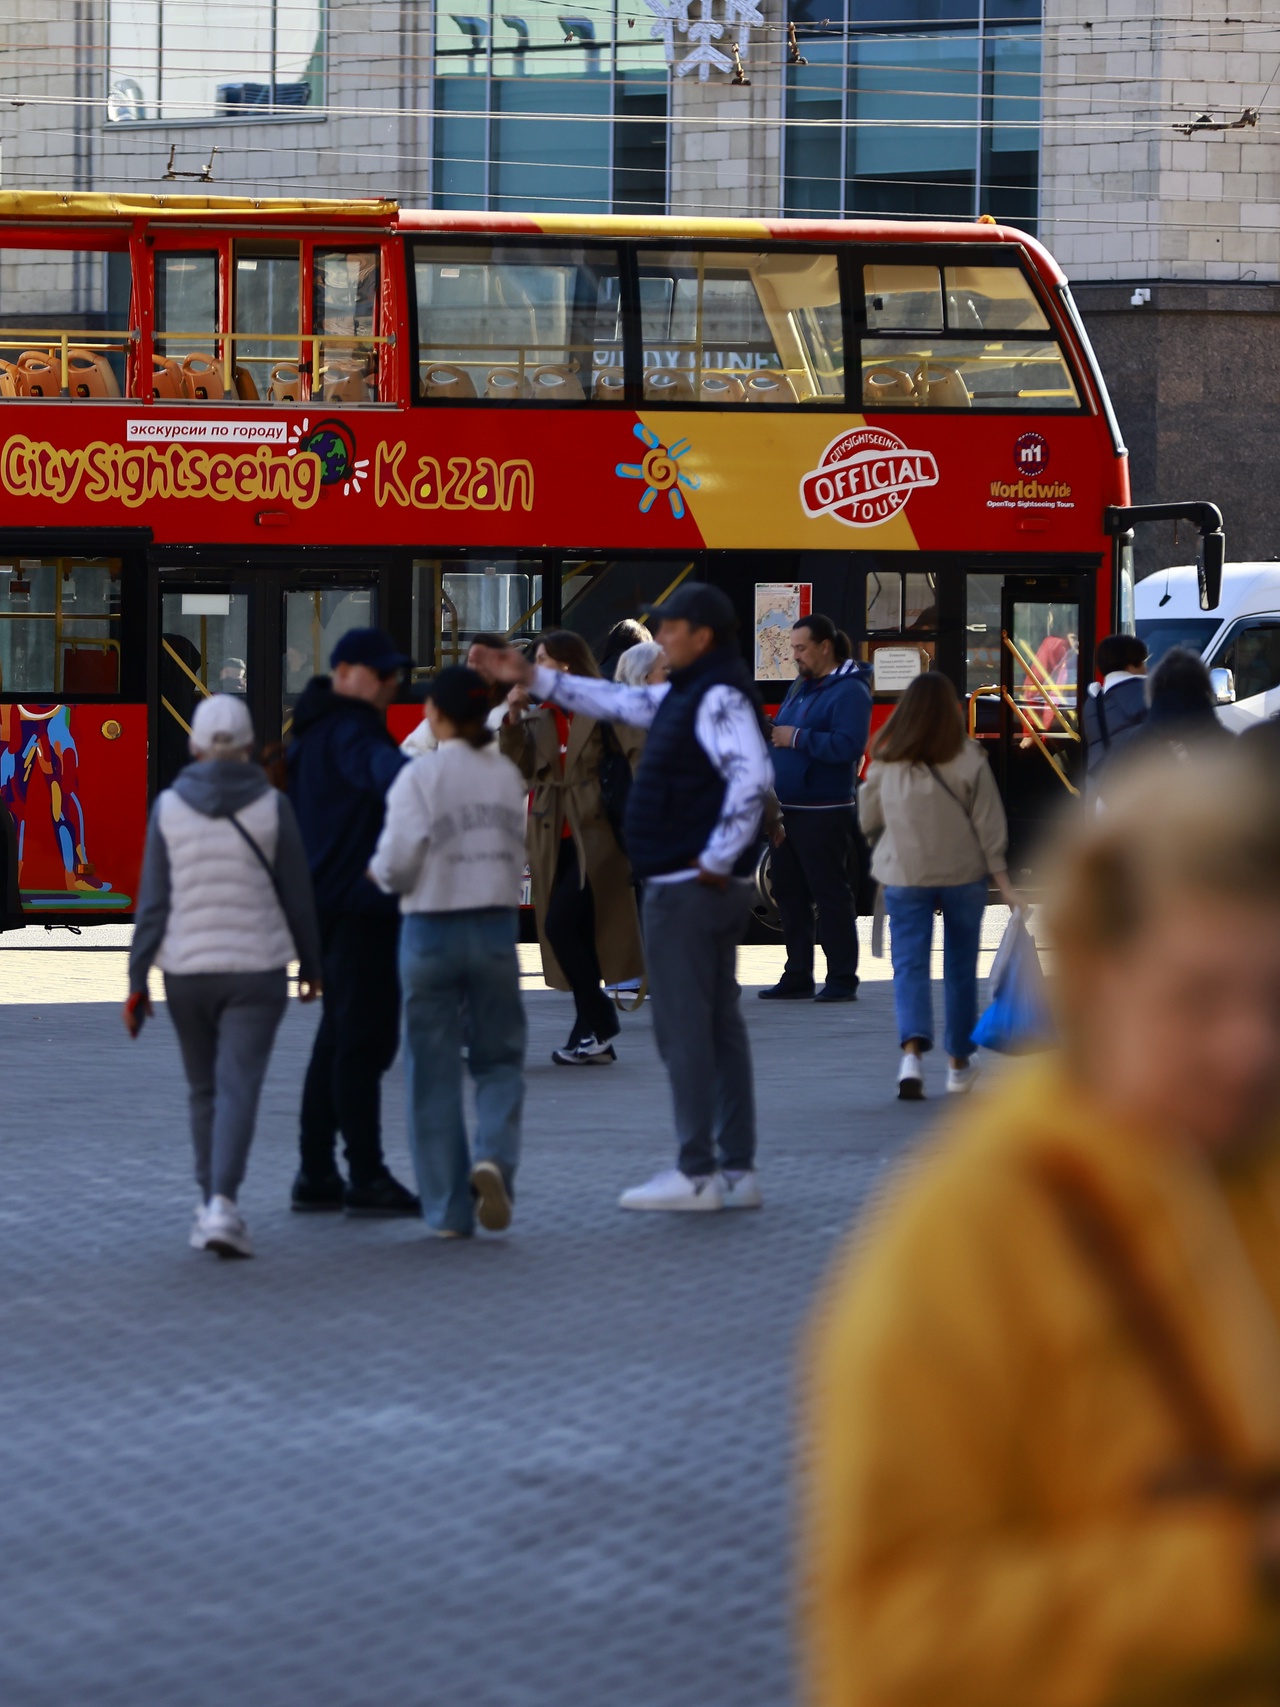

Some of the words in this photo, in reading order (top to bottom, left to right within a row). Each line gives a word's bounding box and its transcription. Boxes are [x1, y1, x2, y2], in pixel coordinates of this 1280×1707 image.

[130, 424, 207, 439] экскурсии
[211, 425, 229, 437] по
[233, 426, 283, 440] городу
[830, 433, 899, 463] CITYSIGHTSEEING
[375, 440, 535, 511] Kazan
[815, 457, 930, 505] OFFICIAL
[990, 480, 1072, 499] Worldwide
[852, 492, 903, 520] TOUR
[986, 500, 1016, 508] OpenTop
[1017, 500, 1056, 509] Sightseeing
[1056, 500, 1075, 508] Tours
